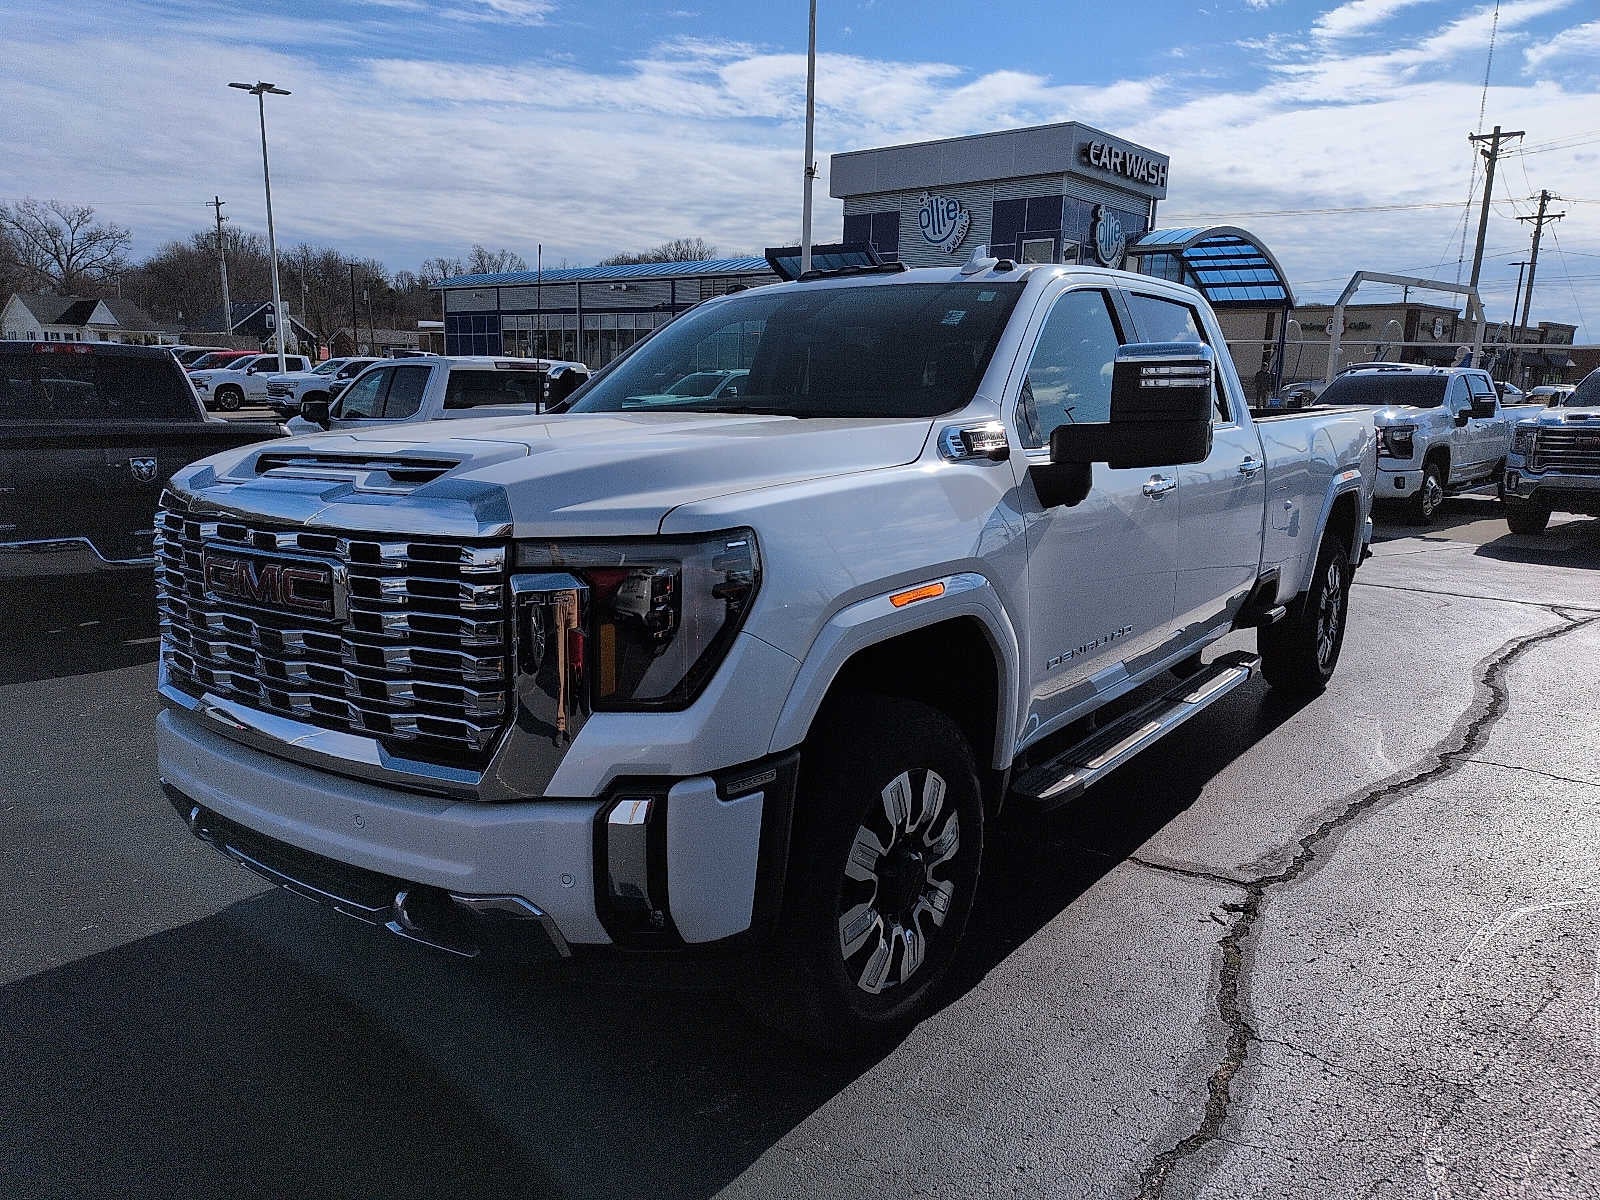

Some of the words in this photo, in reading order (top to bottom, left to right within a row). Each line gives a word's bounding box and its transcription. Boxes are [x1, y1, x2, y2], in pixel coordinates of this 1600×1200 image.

[1088, 141, 1122, 173] CAR
[1124, 151, 1168, 187] WASH
[918, 197, 958, 236] ollie
[205, 556, 331, 612] GMC
